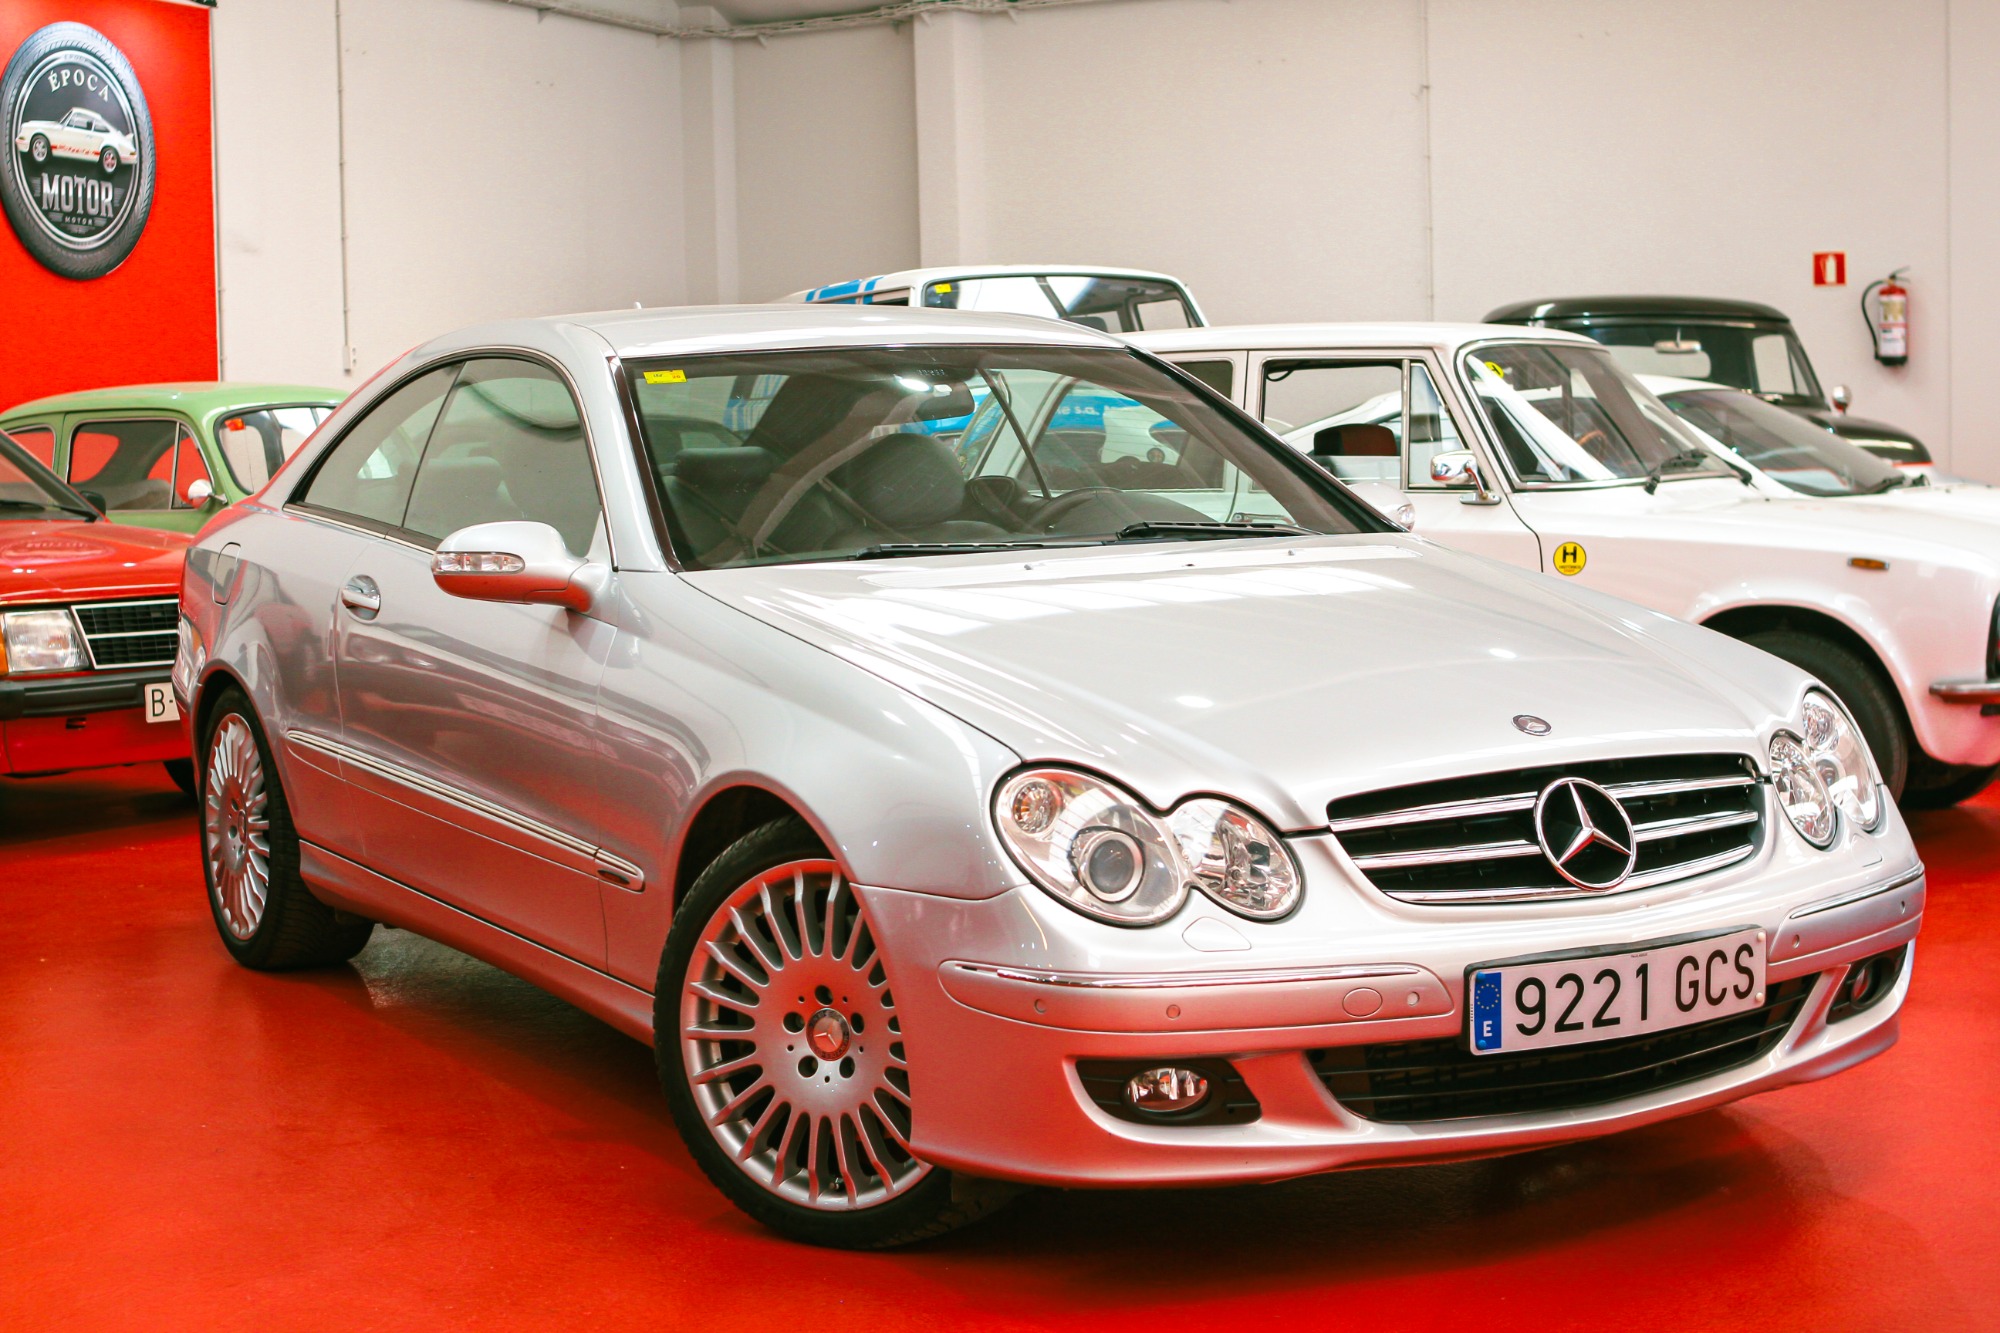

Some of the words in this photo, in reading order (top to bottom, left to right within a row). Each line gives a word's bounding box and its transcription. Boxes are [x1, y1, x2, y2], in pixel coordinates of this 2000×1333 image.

[48, 69, 109, 102] ÉPOCA
[41, 172, 114, 218] MOTOR
[1562, 545, 1577, 563] H
[1514, 962, 1649, 1037] 9221
[1675, 943, 1755, 1013] GCS
[1483, 1020, 1493, 1037] E
